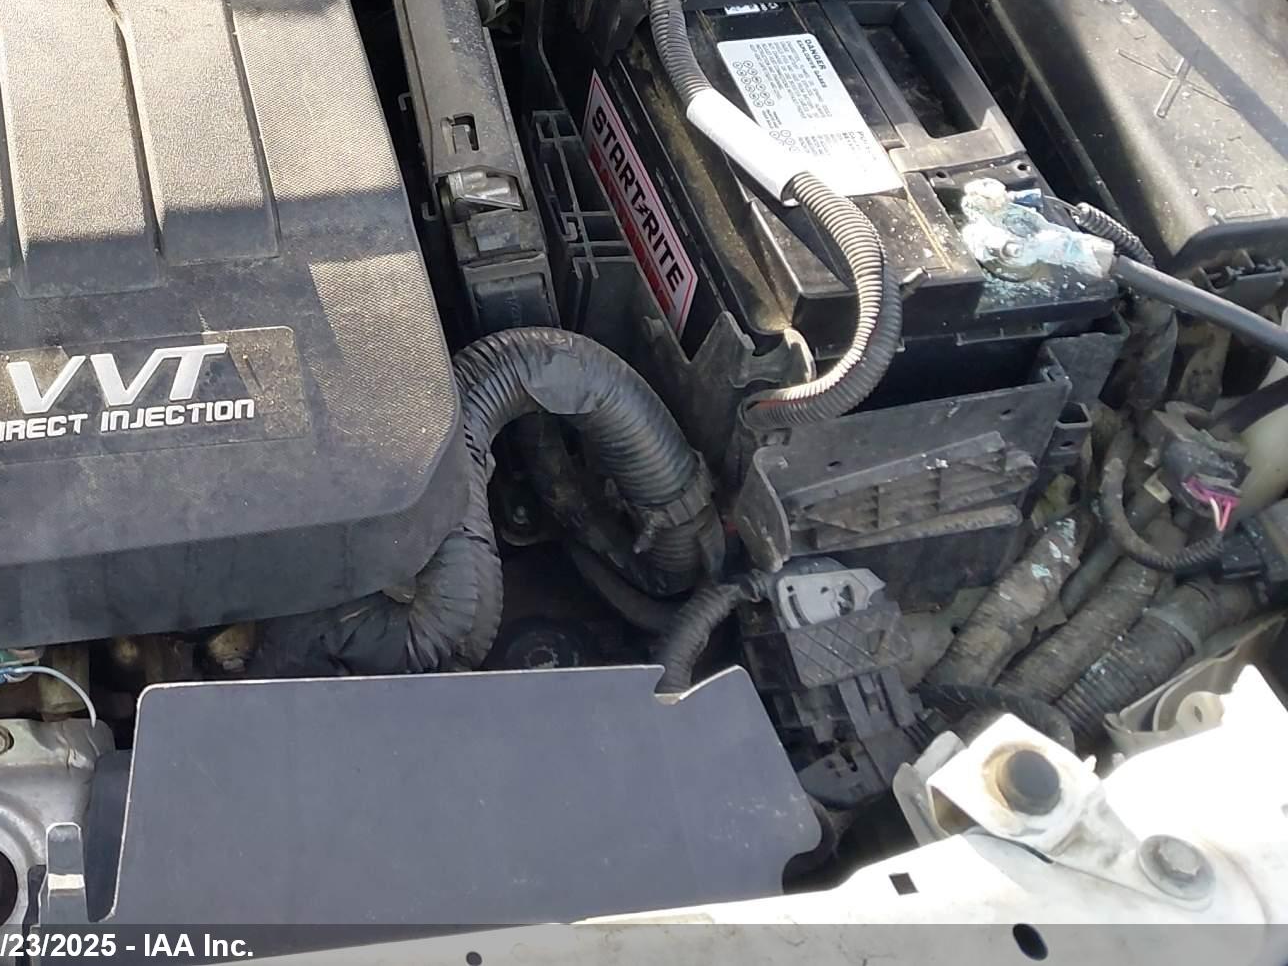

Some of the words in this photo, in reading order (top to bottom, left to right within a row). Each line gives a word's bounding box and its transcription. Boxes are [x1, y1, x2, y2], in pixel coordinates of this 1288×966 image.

[804, 39, 826, 70] DANGER
[6, 344, 228, 414] VVT
[100, 399, 255, 432] INJECTION
